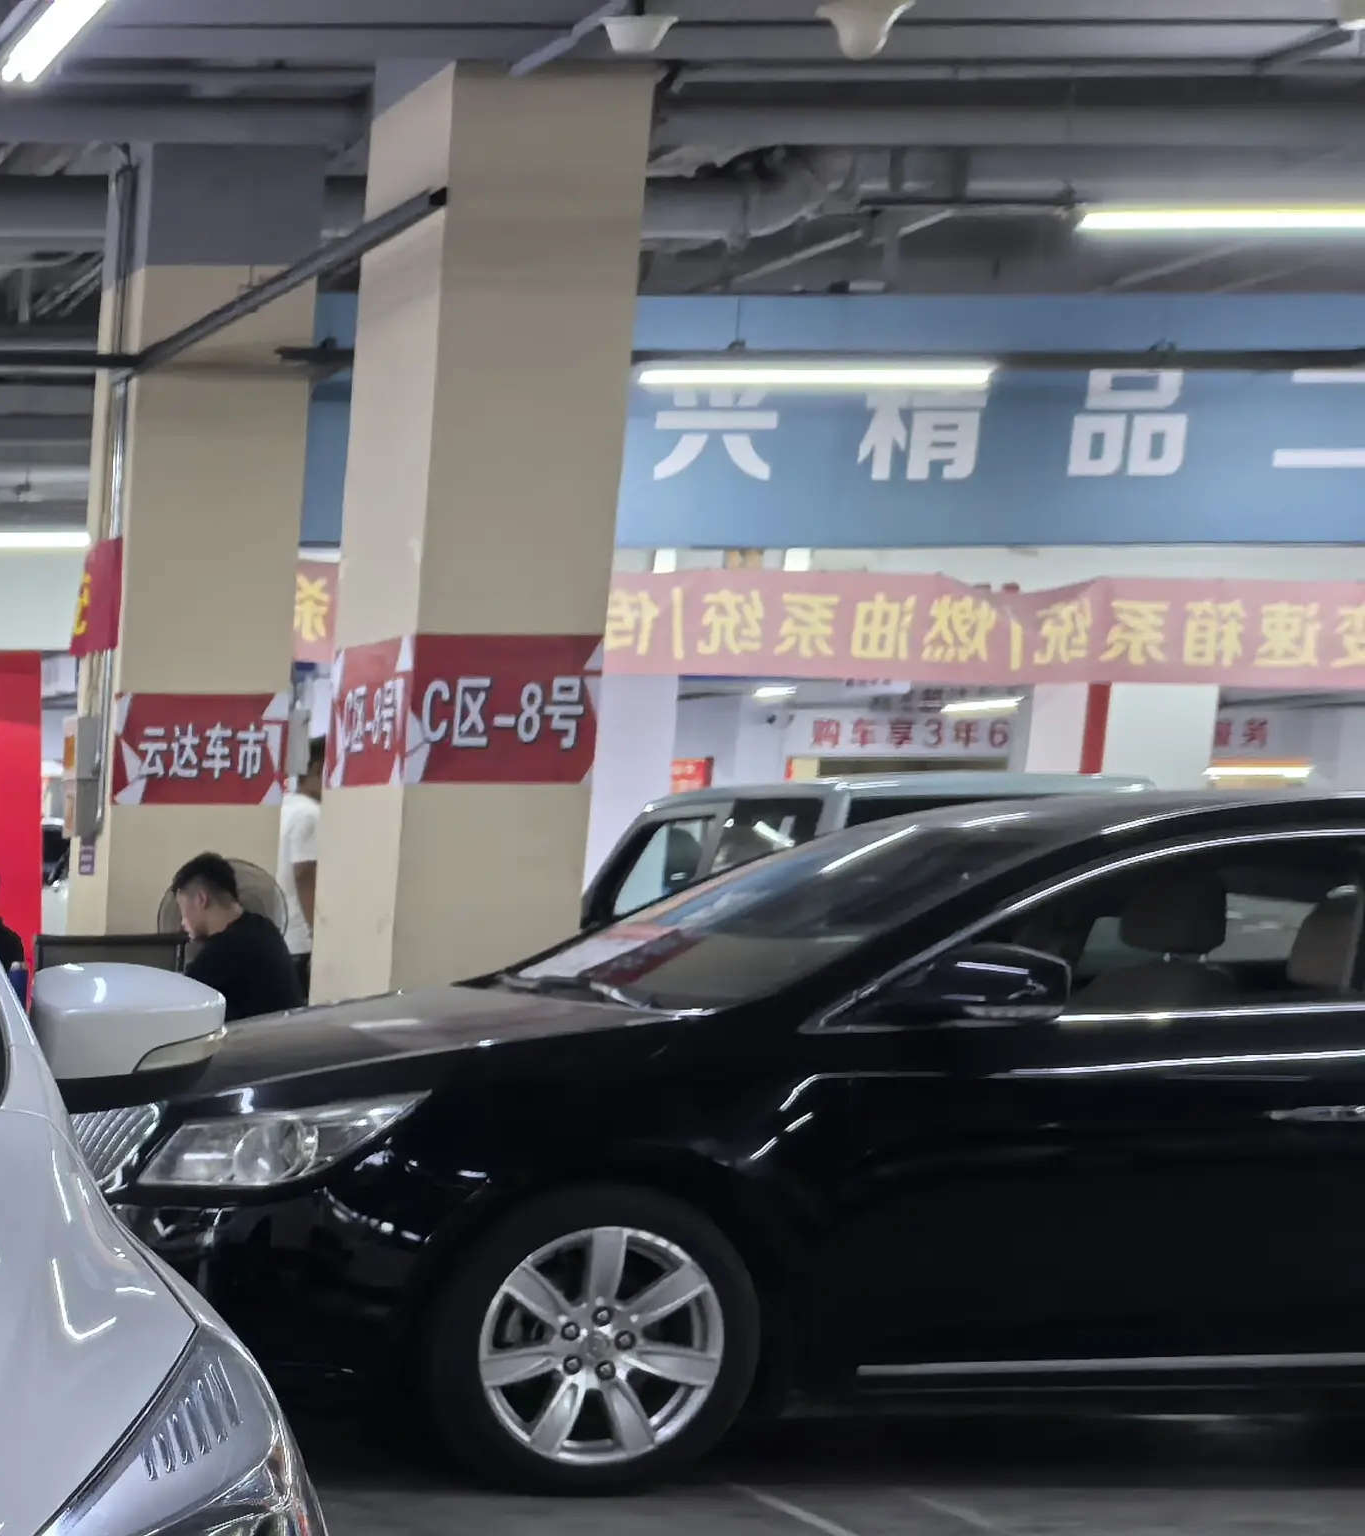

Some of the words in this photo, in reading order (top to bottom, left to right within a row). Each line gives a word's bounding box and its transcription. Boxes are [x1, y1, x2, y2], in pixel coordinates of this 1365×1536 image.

[421, 676, 584, 749] C区-8号
[138, 722, 268, 780] 云达车市
